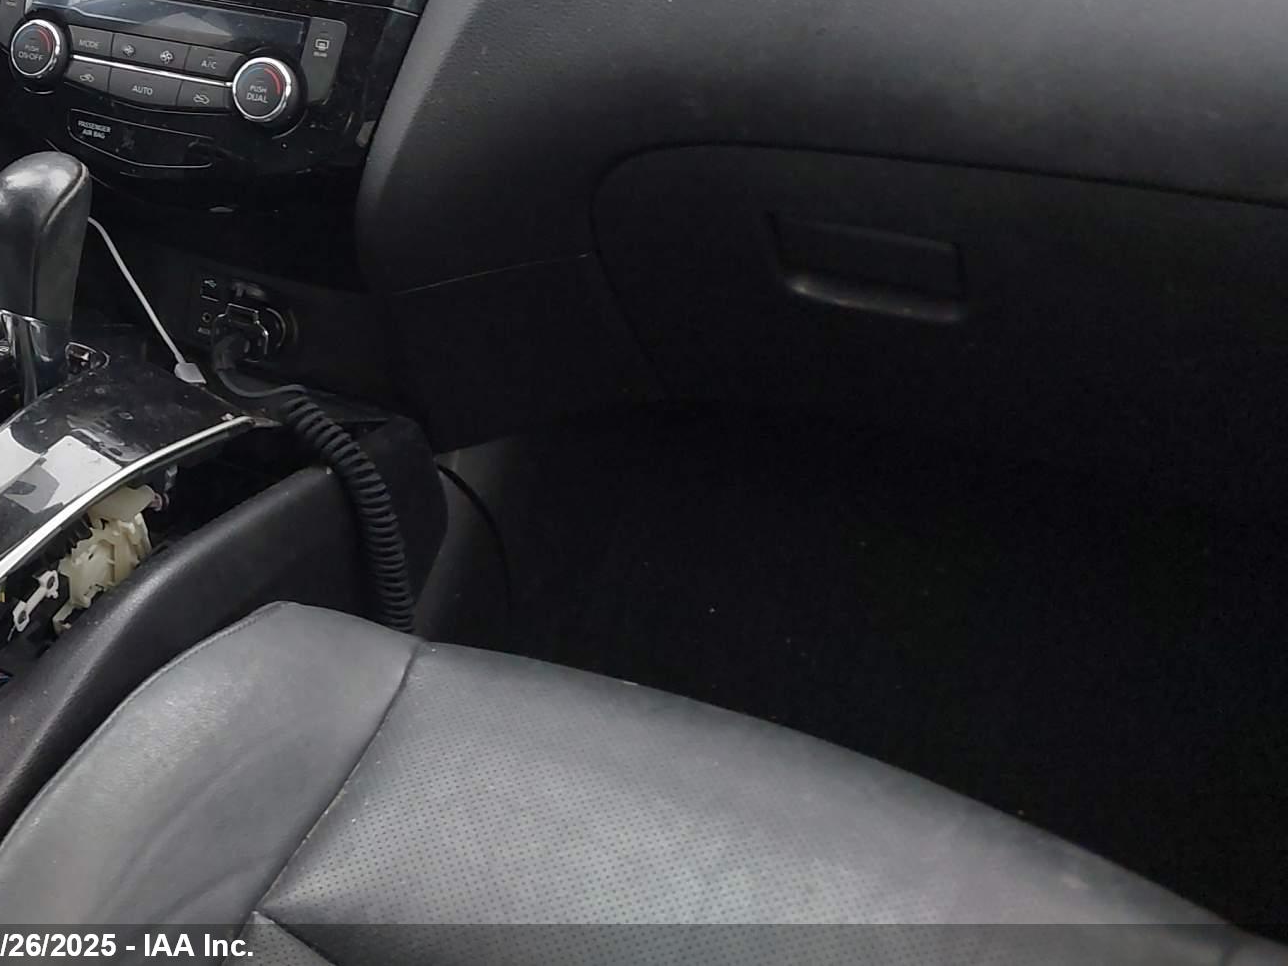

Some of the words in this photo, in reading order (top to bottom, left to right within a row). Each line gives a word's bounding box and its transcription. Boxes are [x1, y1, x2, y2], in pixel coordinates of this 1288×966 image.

[79, 39, 99, 49] MODE
[201, 61, 217, 70] A/C
[132, 85, 153, 96] AUTO
[249, 84, 267, 94] PUSH
[246, 93, 269, 103] DUAL
